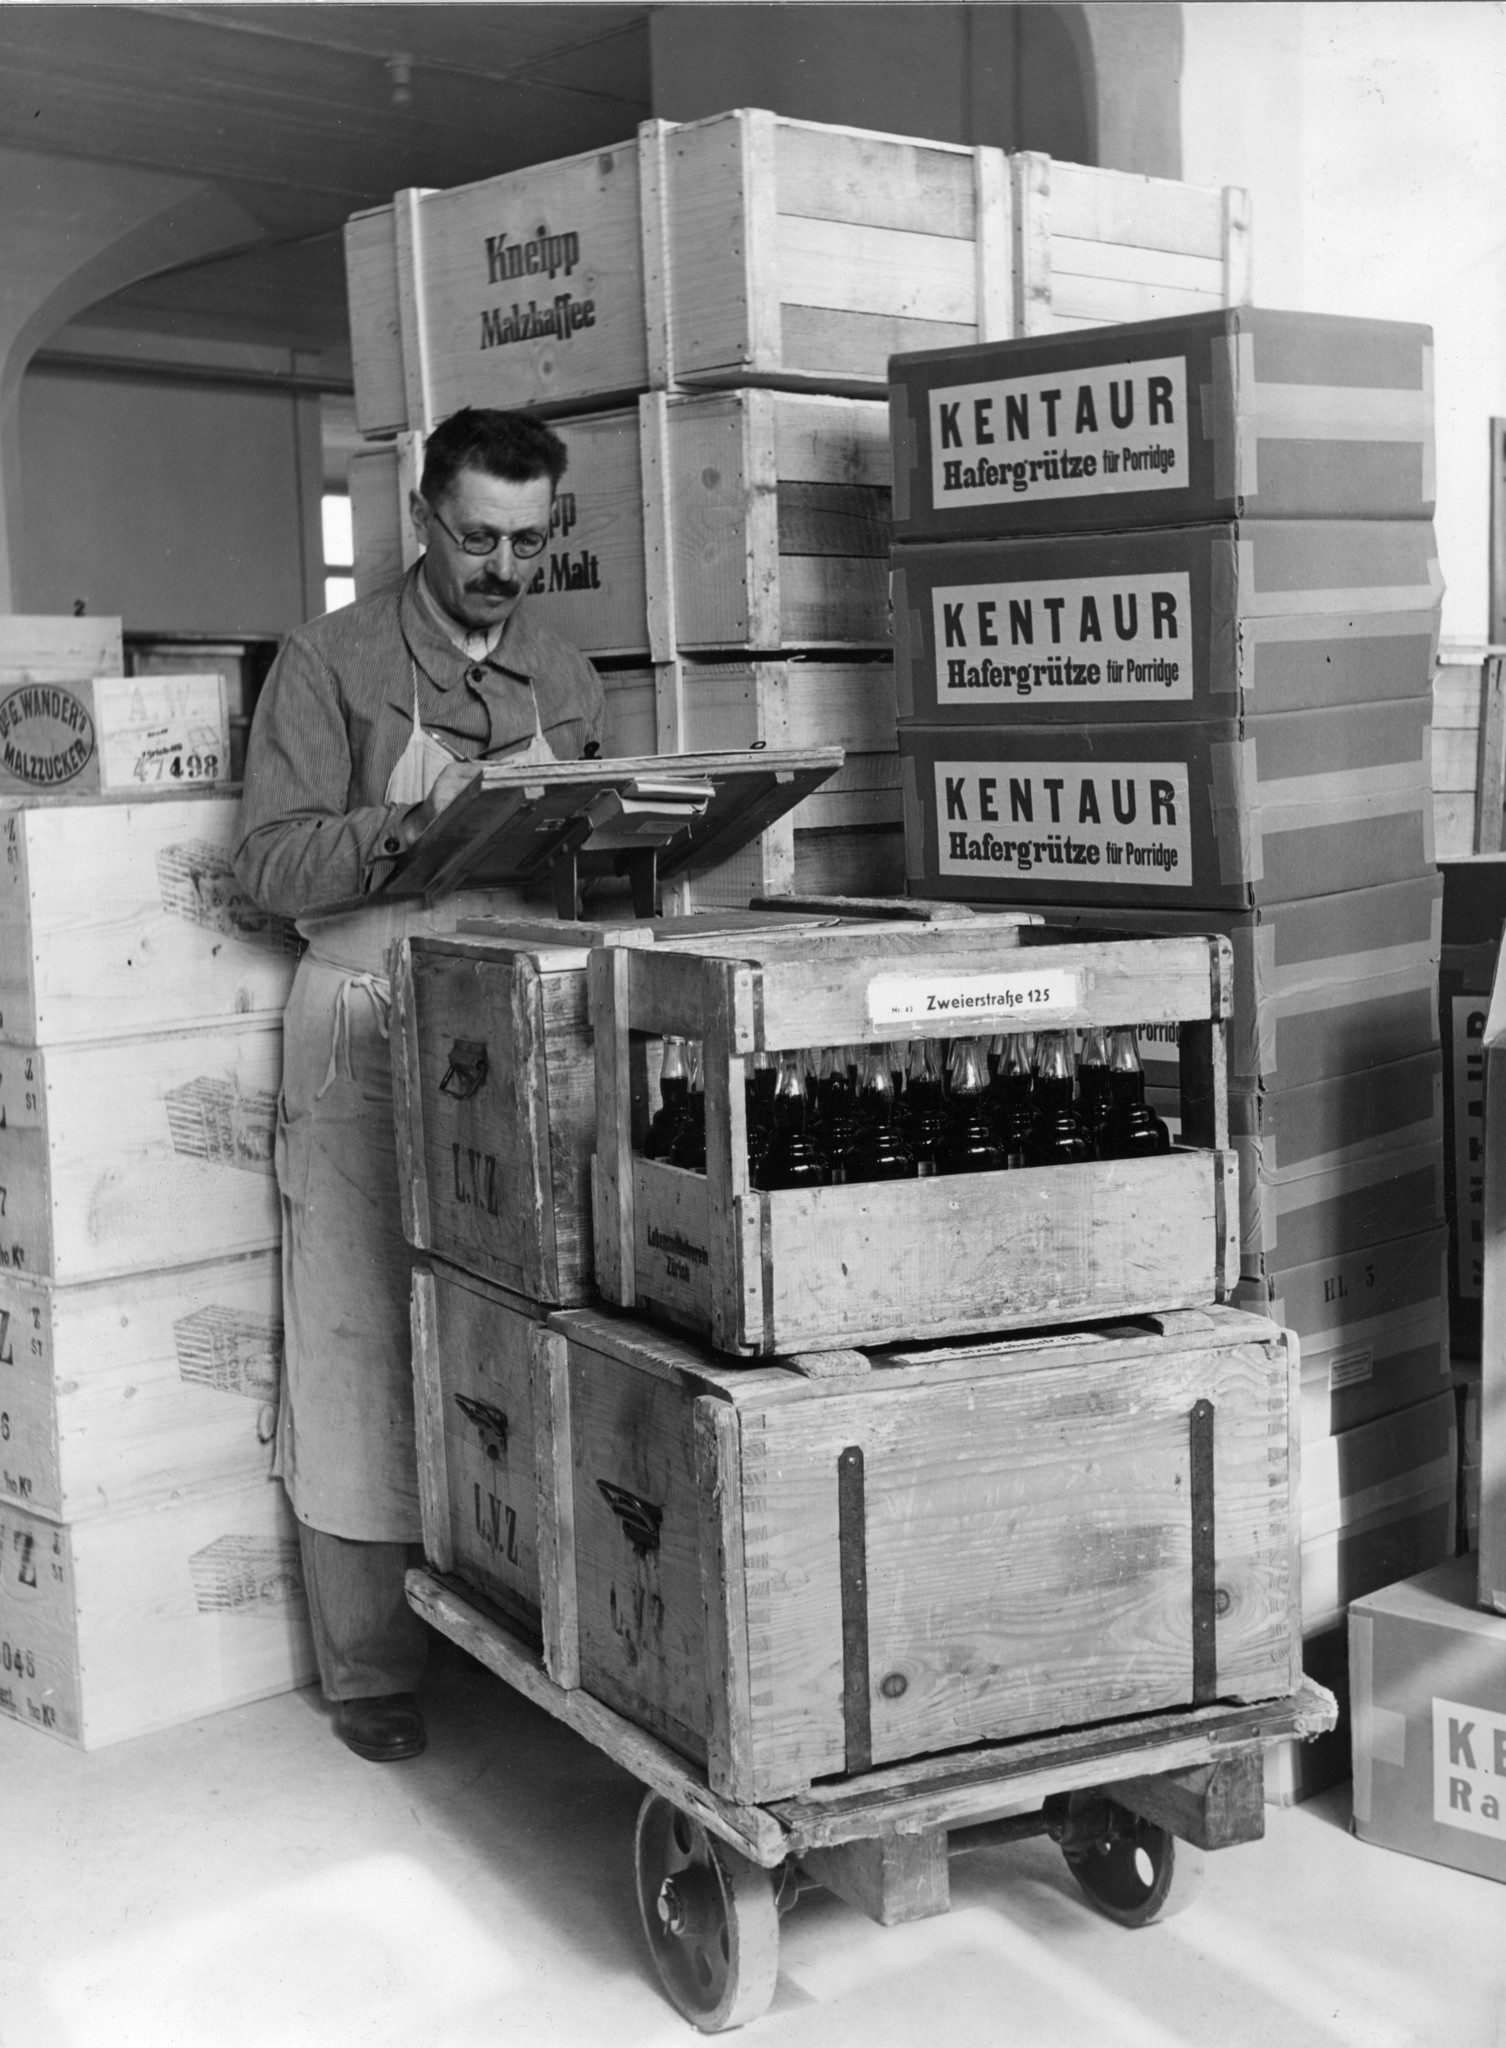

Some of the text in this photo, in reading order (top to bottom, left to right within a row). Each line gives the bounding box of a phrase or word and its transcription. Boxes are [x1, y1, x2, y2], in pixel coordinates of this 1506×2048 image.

[484, 225, 580, 284] Kneipp
[480, 293, 596, 350] Malzkaffee
[940, 376, 1174, 449] KENTAUR
[943, 444, 1175, 492] Hafergrütze für Porridge
[548, 550, 601, 593] Malt
[944, 591, 1178, 647] KENTAUR
[947, 656, 1179, 695] Hafergrütze für Porridge
[4, 738, 87, 781] MALZZUCKER
[945, 777, 1177, 825] KENTAUR
[949, 831, 1178, 872] Hafergrütze für Porridge
[926, 990, 1024, 1011] Zweierstraße
[1028, 988, 1050, 1003] 125
